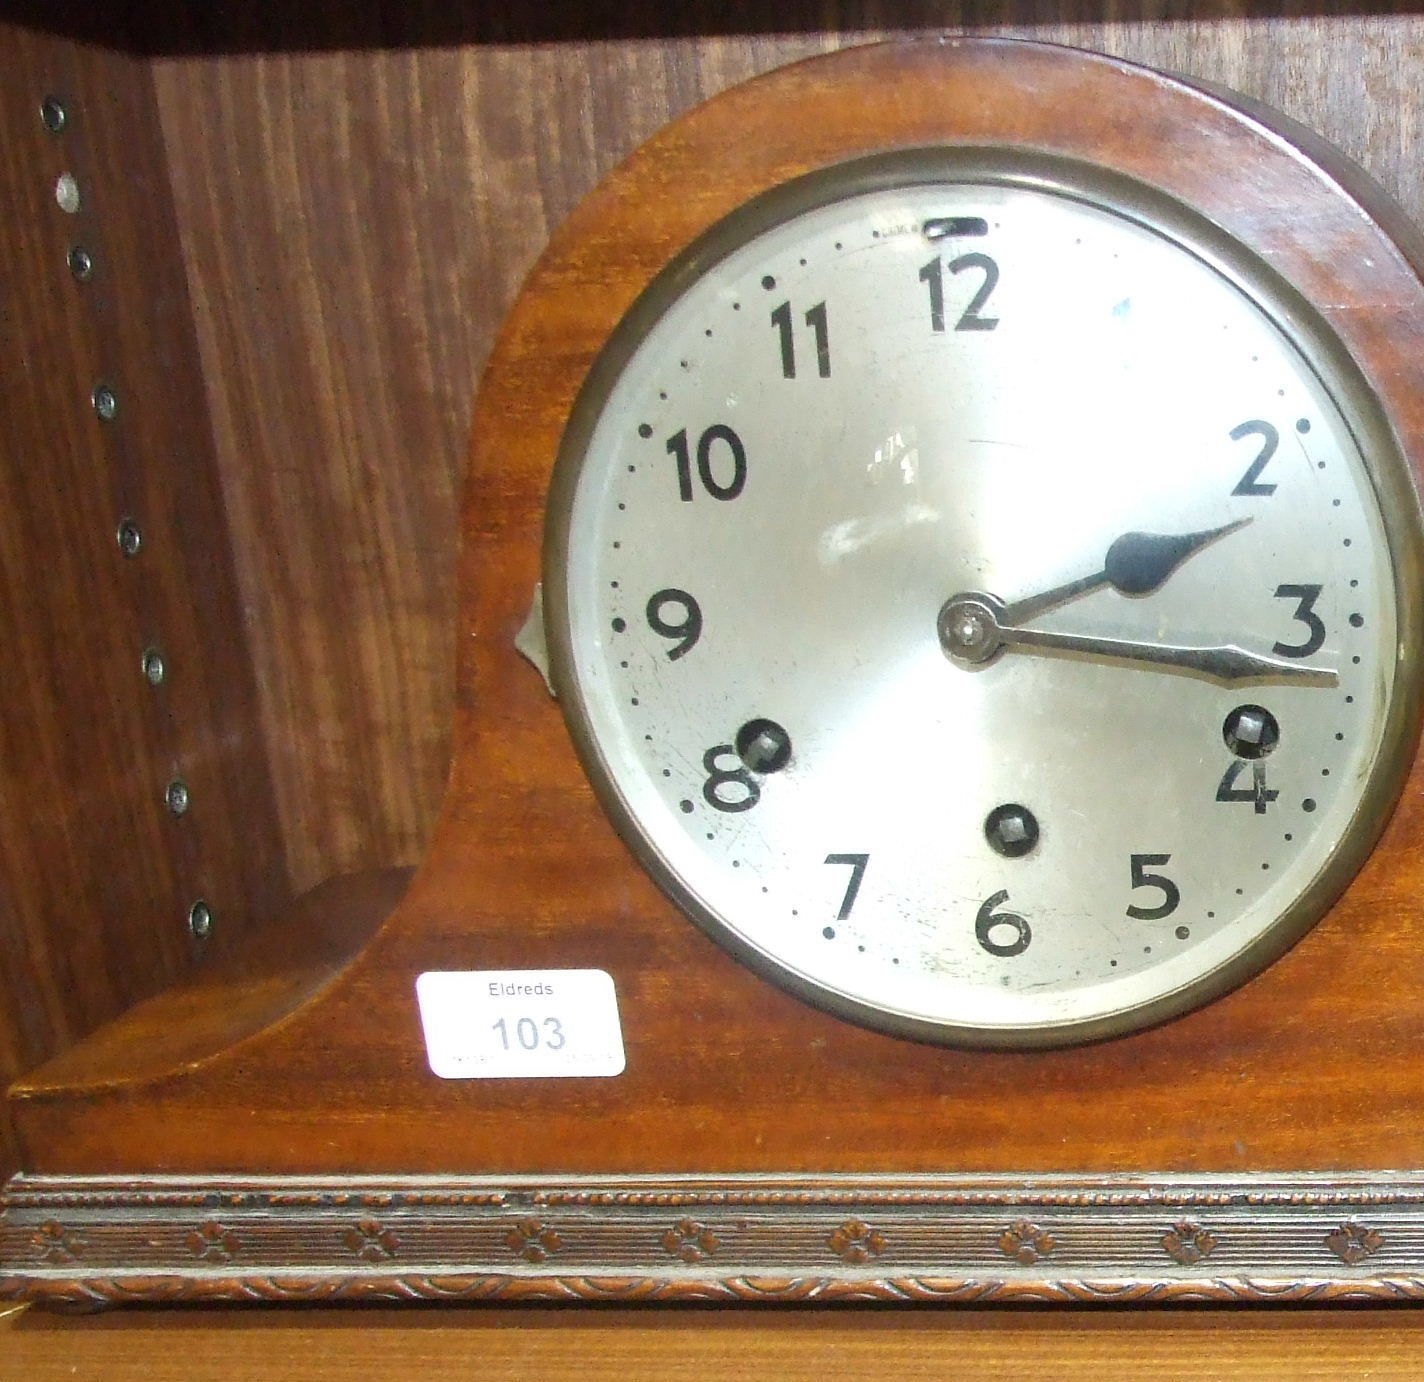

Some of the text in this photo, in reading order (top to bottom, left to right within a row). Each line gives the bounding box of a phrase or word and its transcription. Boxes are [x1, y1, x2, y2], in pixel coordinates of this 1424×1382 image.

[919, 252, 1000, 332] 12
[771, 300, 832, 380] 11
[666, 423, 748, 502] 10
[1229, 419, 1279, 497] 2
[646, 588, 703, 662] 9
[1272, 584, 1325, 659] 3
[702, 744, 761, 813] 8
[1216, 759, 1280, 814] 4
[823, 854, 871, 921] 7
[1126, 853, 1181, 921] 5
[975, 889, 1032, 957] 6
[488, 982, 554, 996] Eldreds
[491, 1016, 566, 1050] 103
